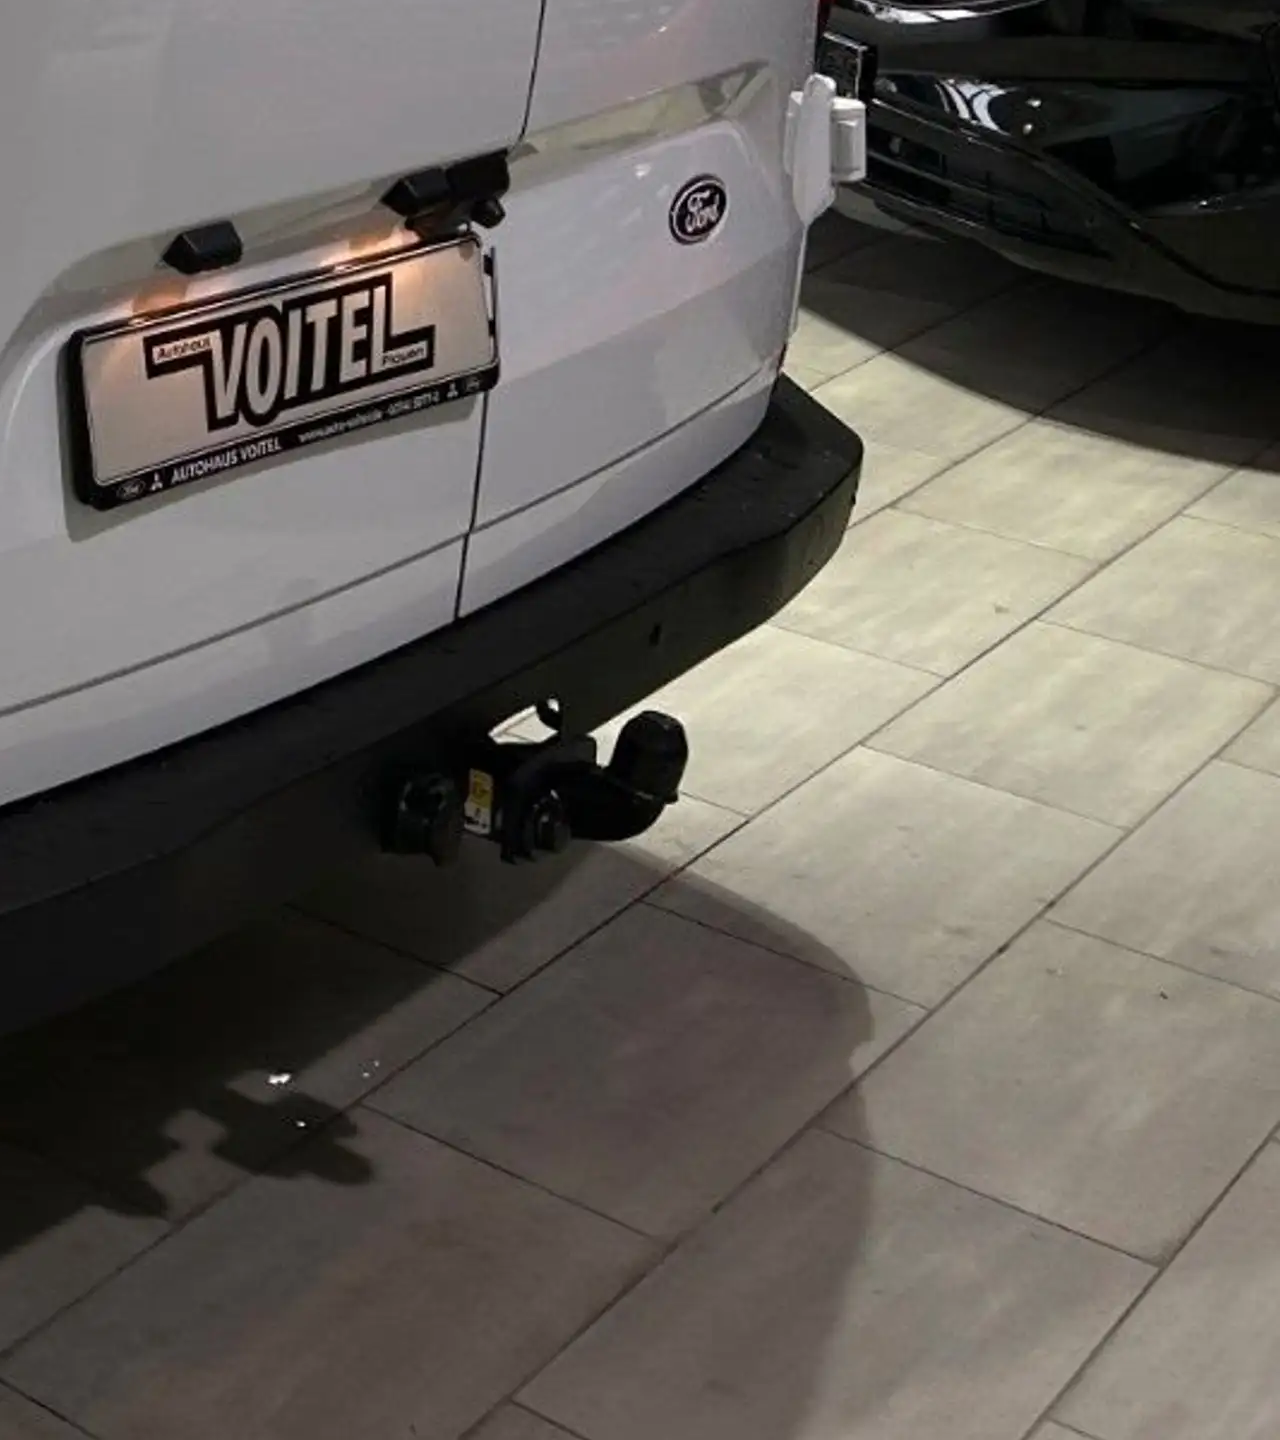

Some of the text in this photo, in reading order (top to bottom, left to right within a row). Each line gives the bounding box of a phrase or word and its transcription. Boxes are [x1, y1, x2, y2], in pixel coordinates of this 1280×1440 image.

[210, 285, 392, 420] VOITEL
[170, 449, 238, 484] AUTOHAUS
[240, 436, 283, 462] VOITEL
